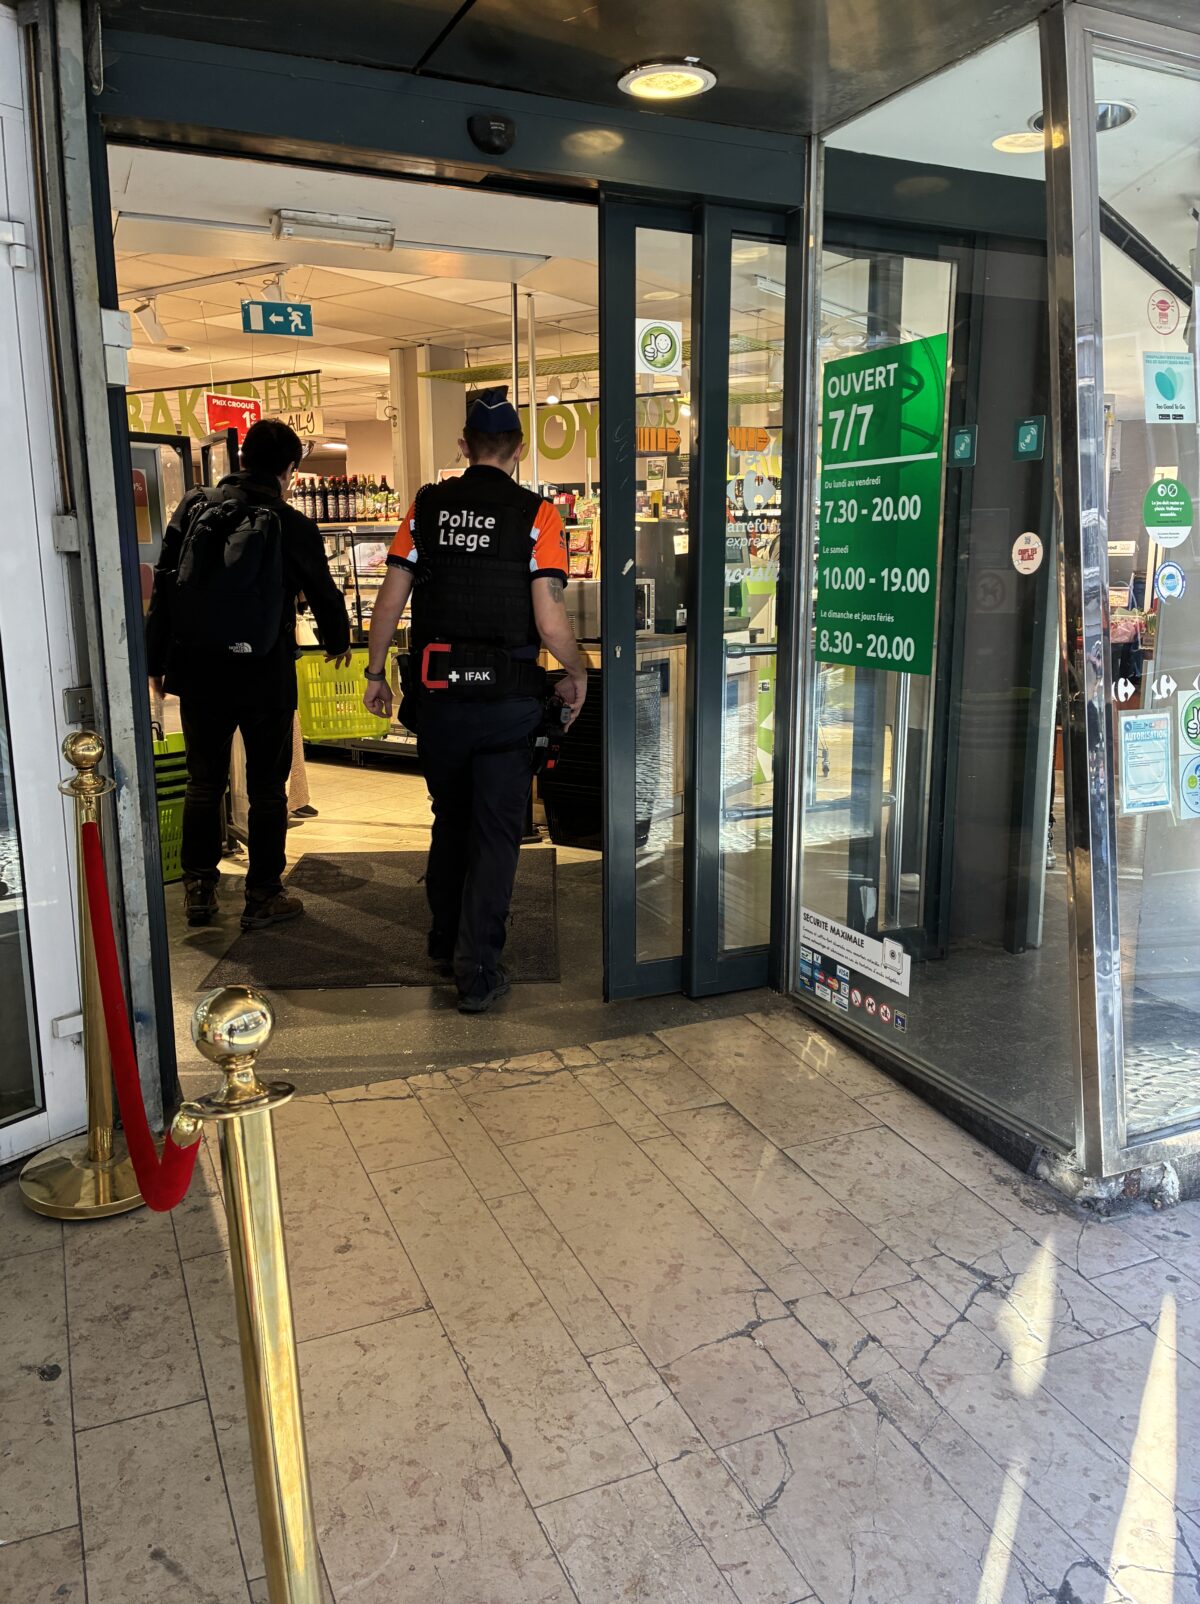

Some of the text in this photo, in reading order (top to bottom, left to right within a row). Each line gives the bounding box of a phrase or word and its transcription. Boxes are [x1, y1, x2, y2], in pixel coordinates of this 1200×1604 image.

[827, 362, 899, 398] OUVERT
[212, 398, 255, 410] PRIX CROQUÉ
[264, 373, 321, 413] FRESH
[828, 403, 874, 452] 7/7
[824, 476, 881, 489] Du lundi au vendredi
[438, 510, 496, 529] Police
[824, 499, 858, 524] 7.30
[871, 494, 922, 522] 20.00
[439, 528, 490, 552] Liege
[822, 545, 849, 554] Le samedi
[823, 566, 866, 591] 10.00
[880, 567, 930, 594] 19.00
[820, 609, 827, 618] Le
[827, 609, 854, 620] dimanche
[860, 613, 876, 622] jours
[876, 612, 895, 623] fériés
[820, 629, 853, 655] 8.30
[866, 633, 915, 662] 20.00
[465, 671, 491, 681] IFAK
[830, 925, 864, 948] MAXIMALE
[838, 968, 849, 978] VISA
